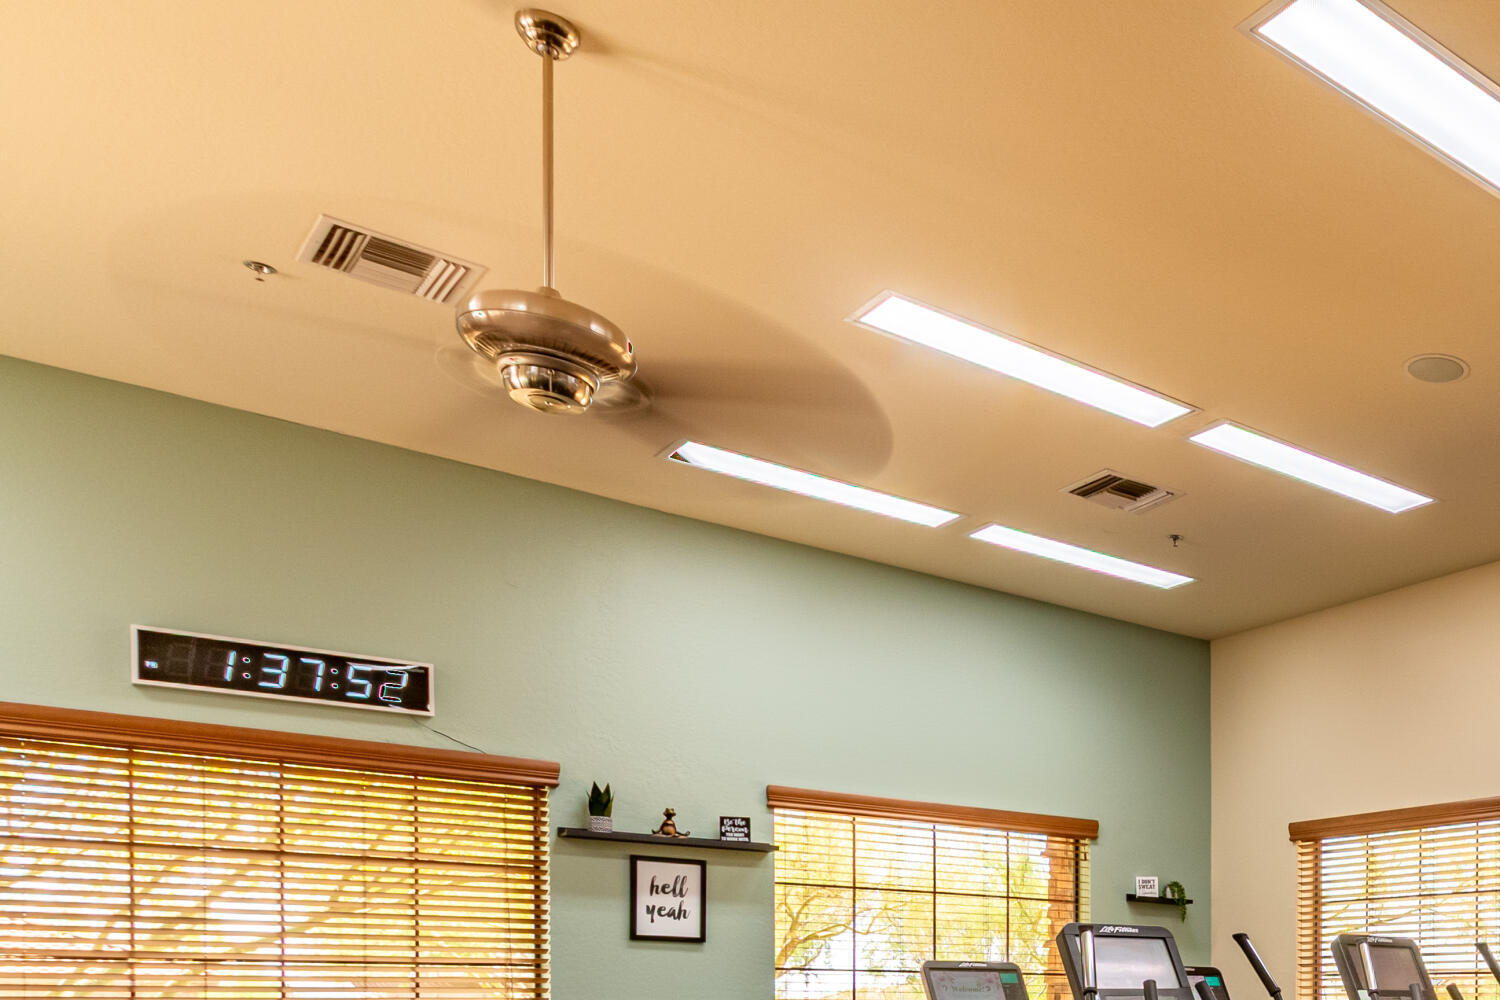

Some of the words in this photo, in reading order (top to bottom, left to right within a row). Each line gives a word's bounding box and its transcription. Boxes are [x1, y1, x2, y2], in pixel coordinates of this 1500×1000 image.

[223, 650, 409, 702] 1:37:52
[649, 875, 689, 898] hell
[645, 899, 691, 923] yeah
